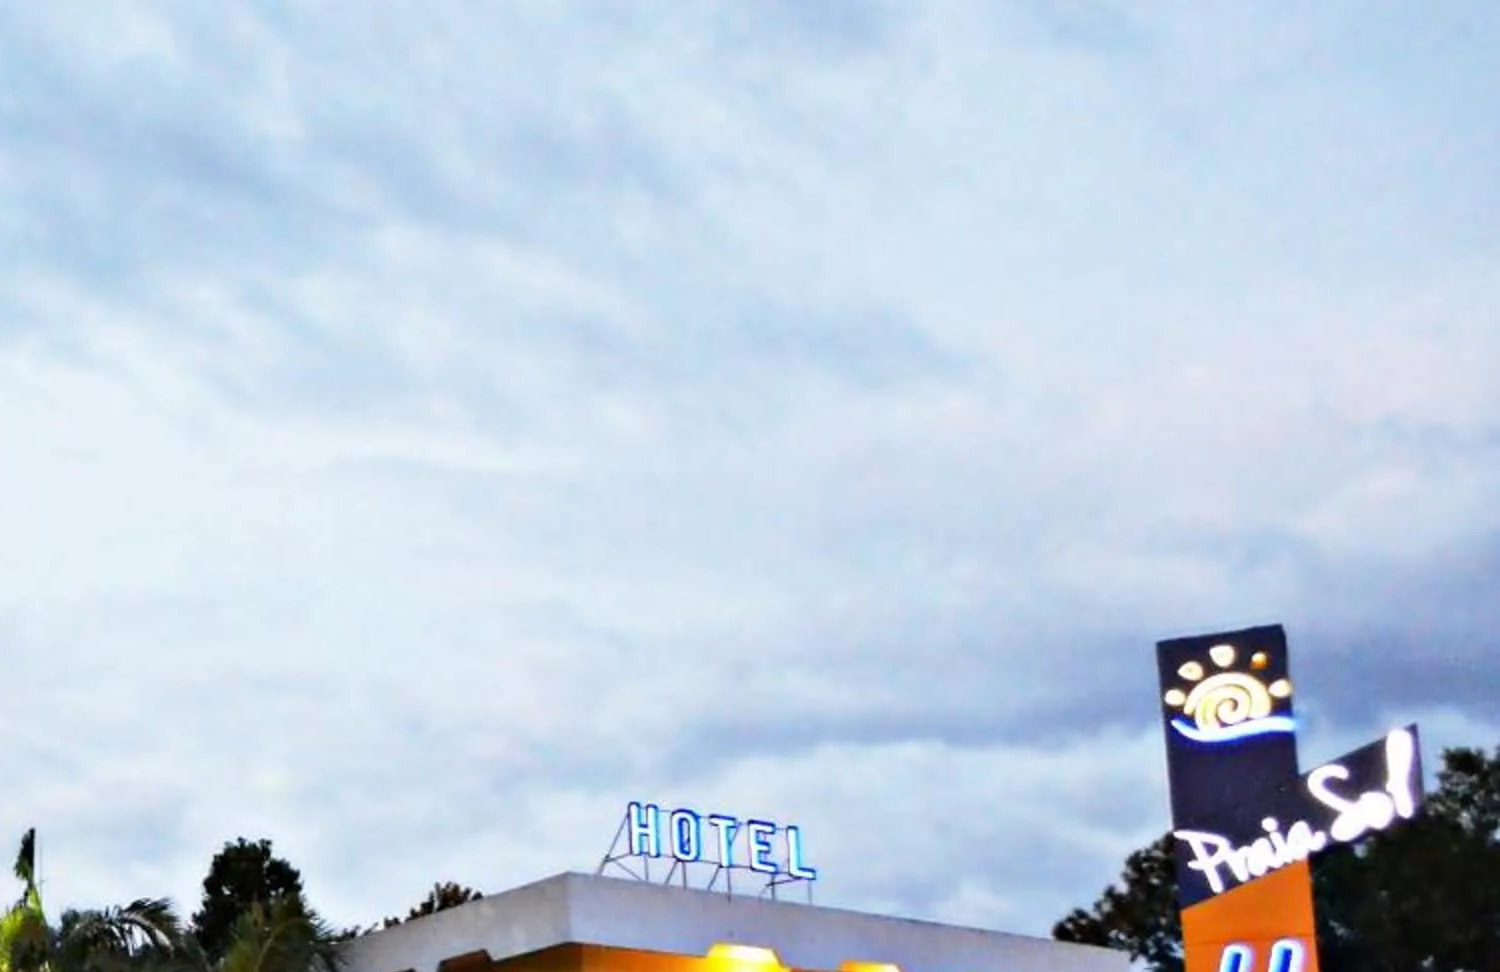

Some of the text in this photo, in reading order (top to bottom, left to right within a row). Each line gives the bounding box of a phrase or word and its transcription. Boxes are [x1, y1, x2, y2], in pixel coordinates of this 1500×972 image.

[627, 801, 817, 881] HOTEL
[1173, 727, 1415, 895] Praia Sol
